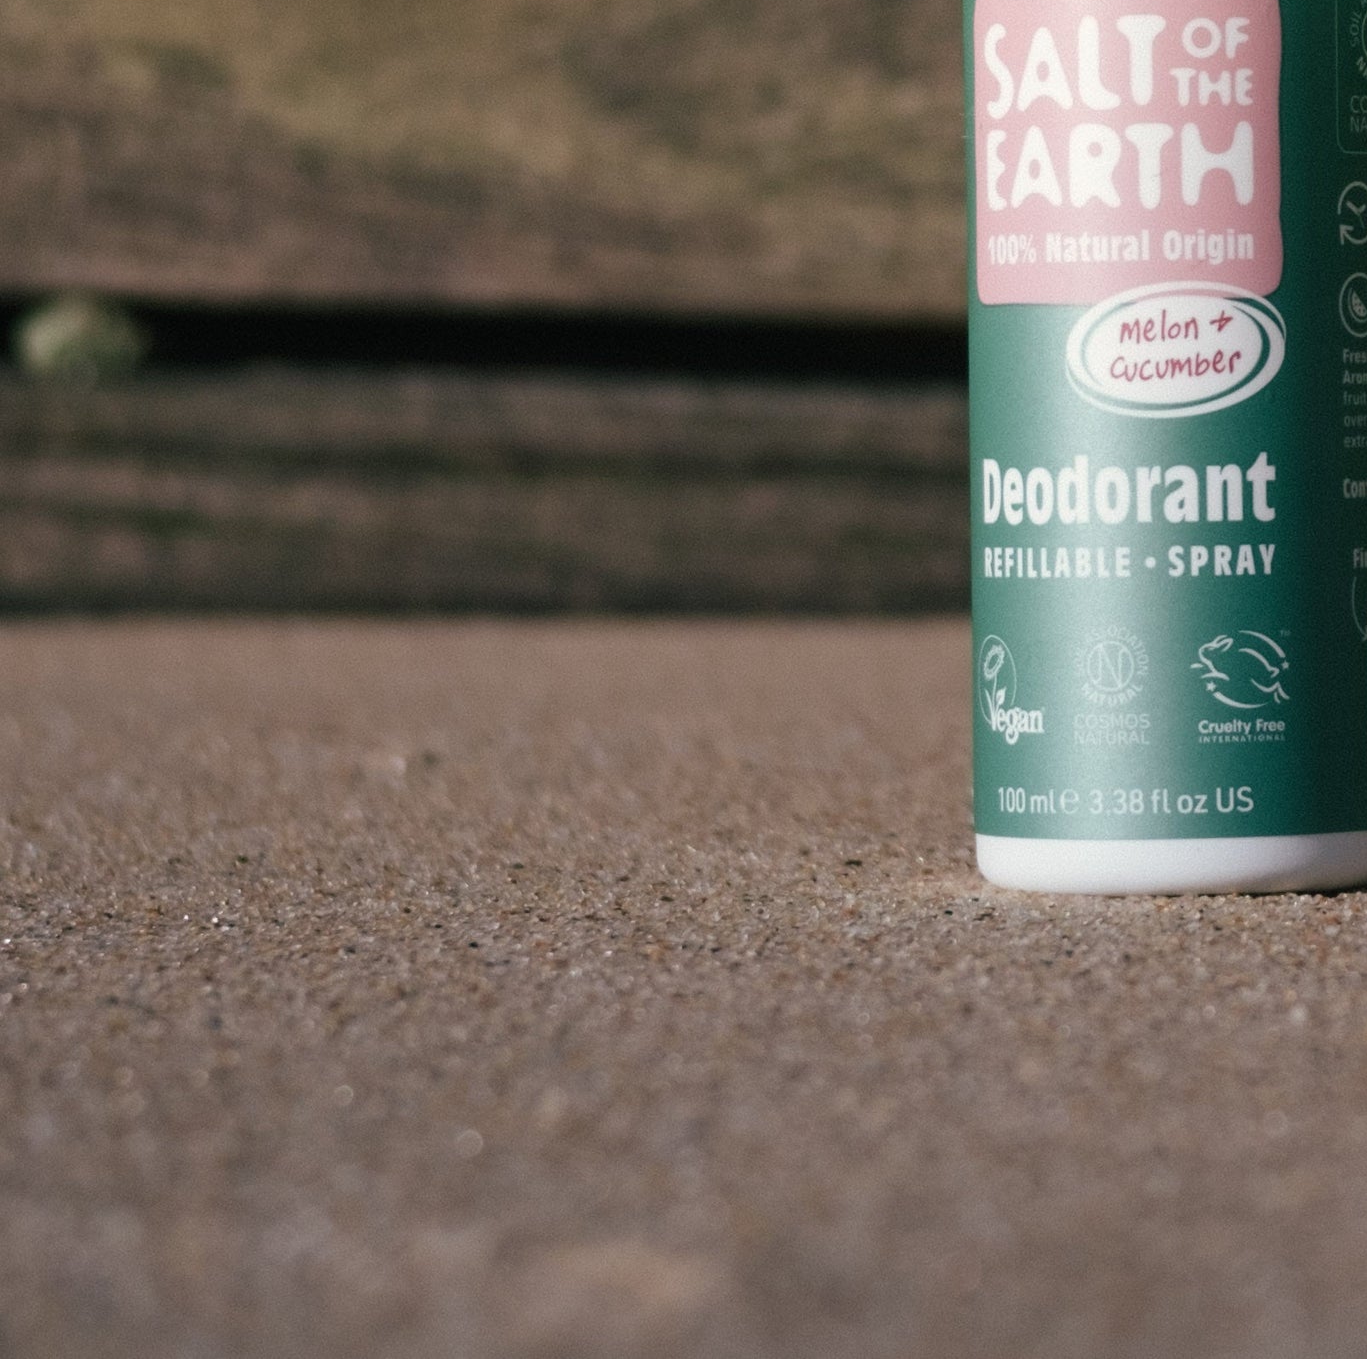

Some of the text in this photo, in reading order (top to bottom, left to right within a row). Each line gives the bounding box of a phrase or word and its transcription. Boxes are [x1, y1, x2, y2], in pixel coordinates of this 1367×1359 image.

[984, 14, 1250, 119] SALT OF
[1169, 67, 1254, 107] THE
[986, 121, 1254, 211] EARTH
[988, 229, 1254, 266] 100% Natural Origin
[1344, 414, 1367, 427] over
[982, 451, 1277, 526] Deodorant
[984, 544, 1276, 579] REFILLABLE SPRAY
[985, 693, 1045, 745] Vegan
[1073, 713, 1151, 729] COSMOS
[1198, 719, 1286, 735] Cruelty Free
[1073, 731, 1151, 746] NATURAL
[1198, 734, 1286, 743] INTERNATIONAL
[999, 788, 1025, 813] 100
[1031, 789, 1055, 814] ml
[1088, 789, 1144, 814] 3.38
[1151, 788, 1171, 814] fl
[1177, 793, 1208, 814] oz
[1215, 786, 1254, 814] US
